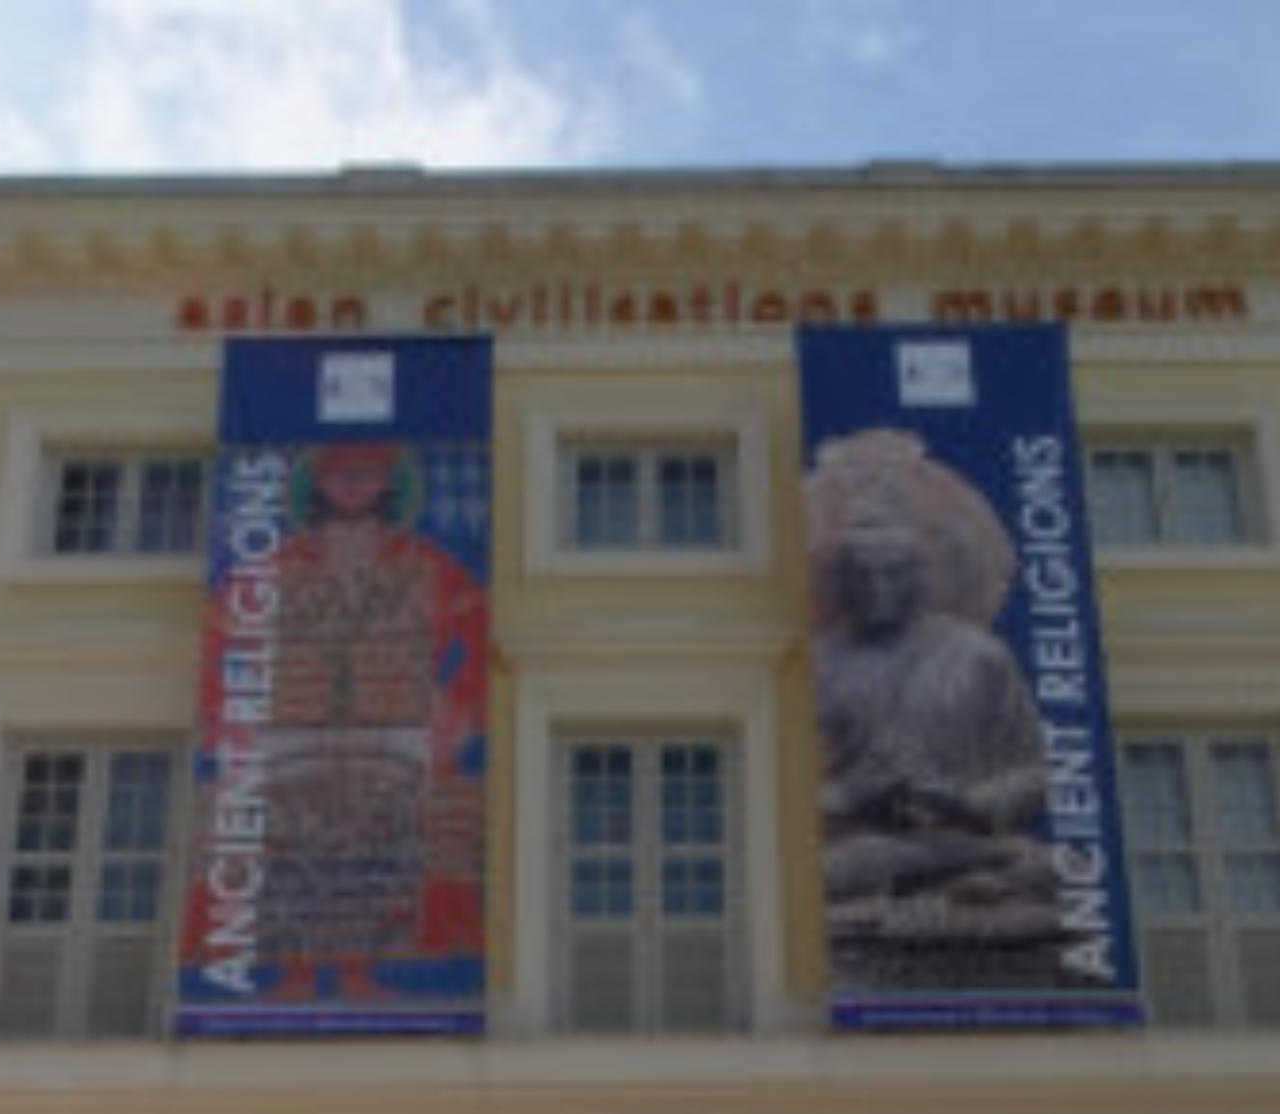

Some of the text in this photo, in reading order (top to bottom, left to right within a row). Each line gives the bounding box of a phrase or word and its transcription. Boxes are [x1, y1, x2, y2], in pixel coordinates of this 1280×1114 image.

[177, 285, 368, 332] asian
[932, 287, 1247, 324] museum
[201, 451, 285, 992] ANCIENT RELIGIONS
[1015, 434, 1116, 984] ANCIENT RELIGIONS
